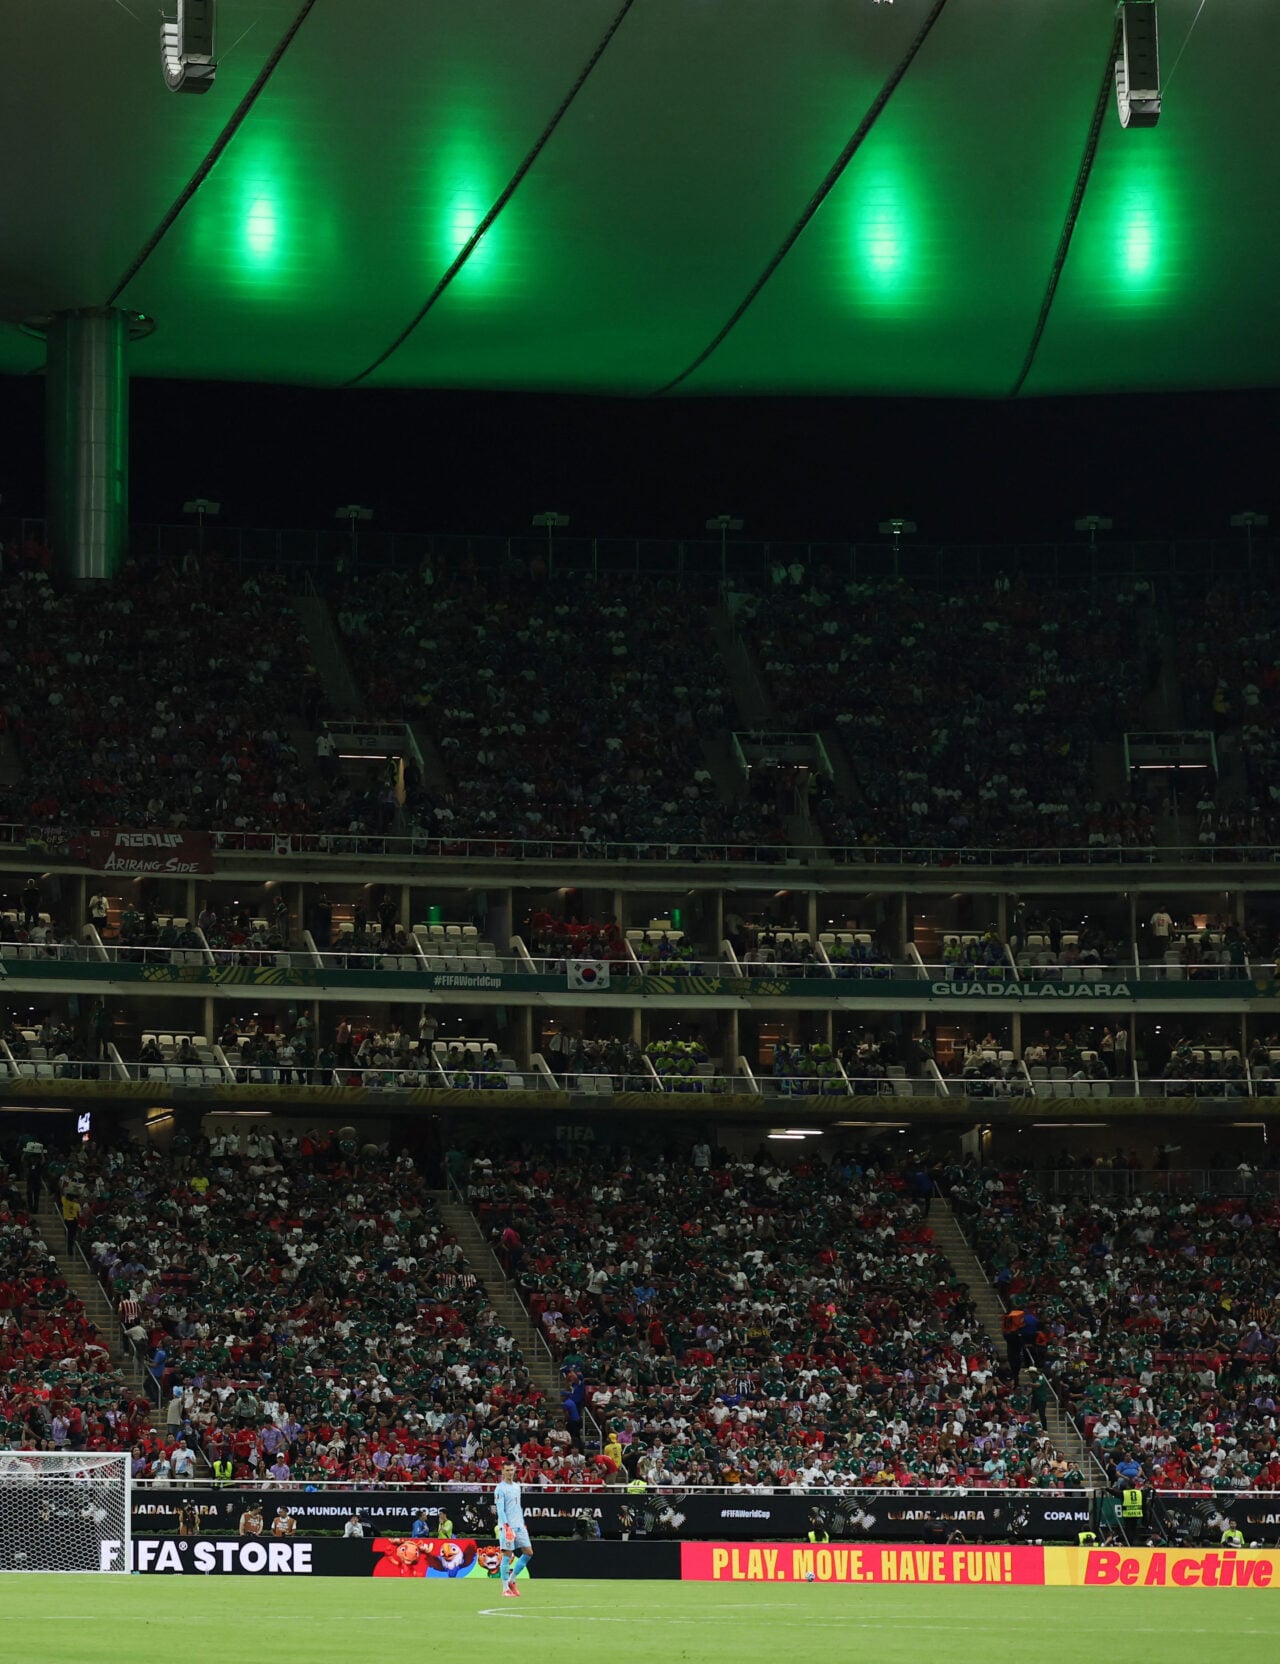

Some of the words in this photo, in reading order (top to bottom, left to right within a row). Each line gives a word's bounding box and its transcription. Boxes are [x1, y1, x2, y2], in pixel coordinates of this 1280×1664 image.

[104, 851, 162, 871] ARIRANG
[165, 857, 200, 873] SIDE
[433, 975, 502, 988] #FIFAWorldCup
[931, 983, 1131, 997] GUADALAJARA
[556, 1126, 595, 1141] FIFA
[307, 1507, 353, 1516] MUNDIAL
[371, 1507, 384, 1516] LA
[386, 1507, 408, 1516] FIFA
[721, 1510, 770, 1519] #FIFAWorldCup
[1044, 1511, 1072, 1521] COPA
[194, 1542, 313, 1573] STORE
[713, 1548, 784, 1580] PLAY.
[792, 1549, 873, 1581] MOVE.
[881, 1550, 947, 1582] HAVE
[952, 1551, 1013, 1583] FUN!
[1084, 1550, 1140, 1585] Be
[1144, 1551, 1273, 1587] Active
